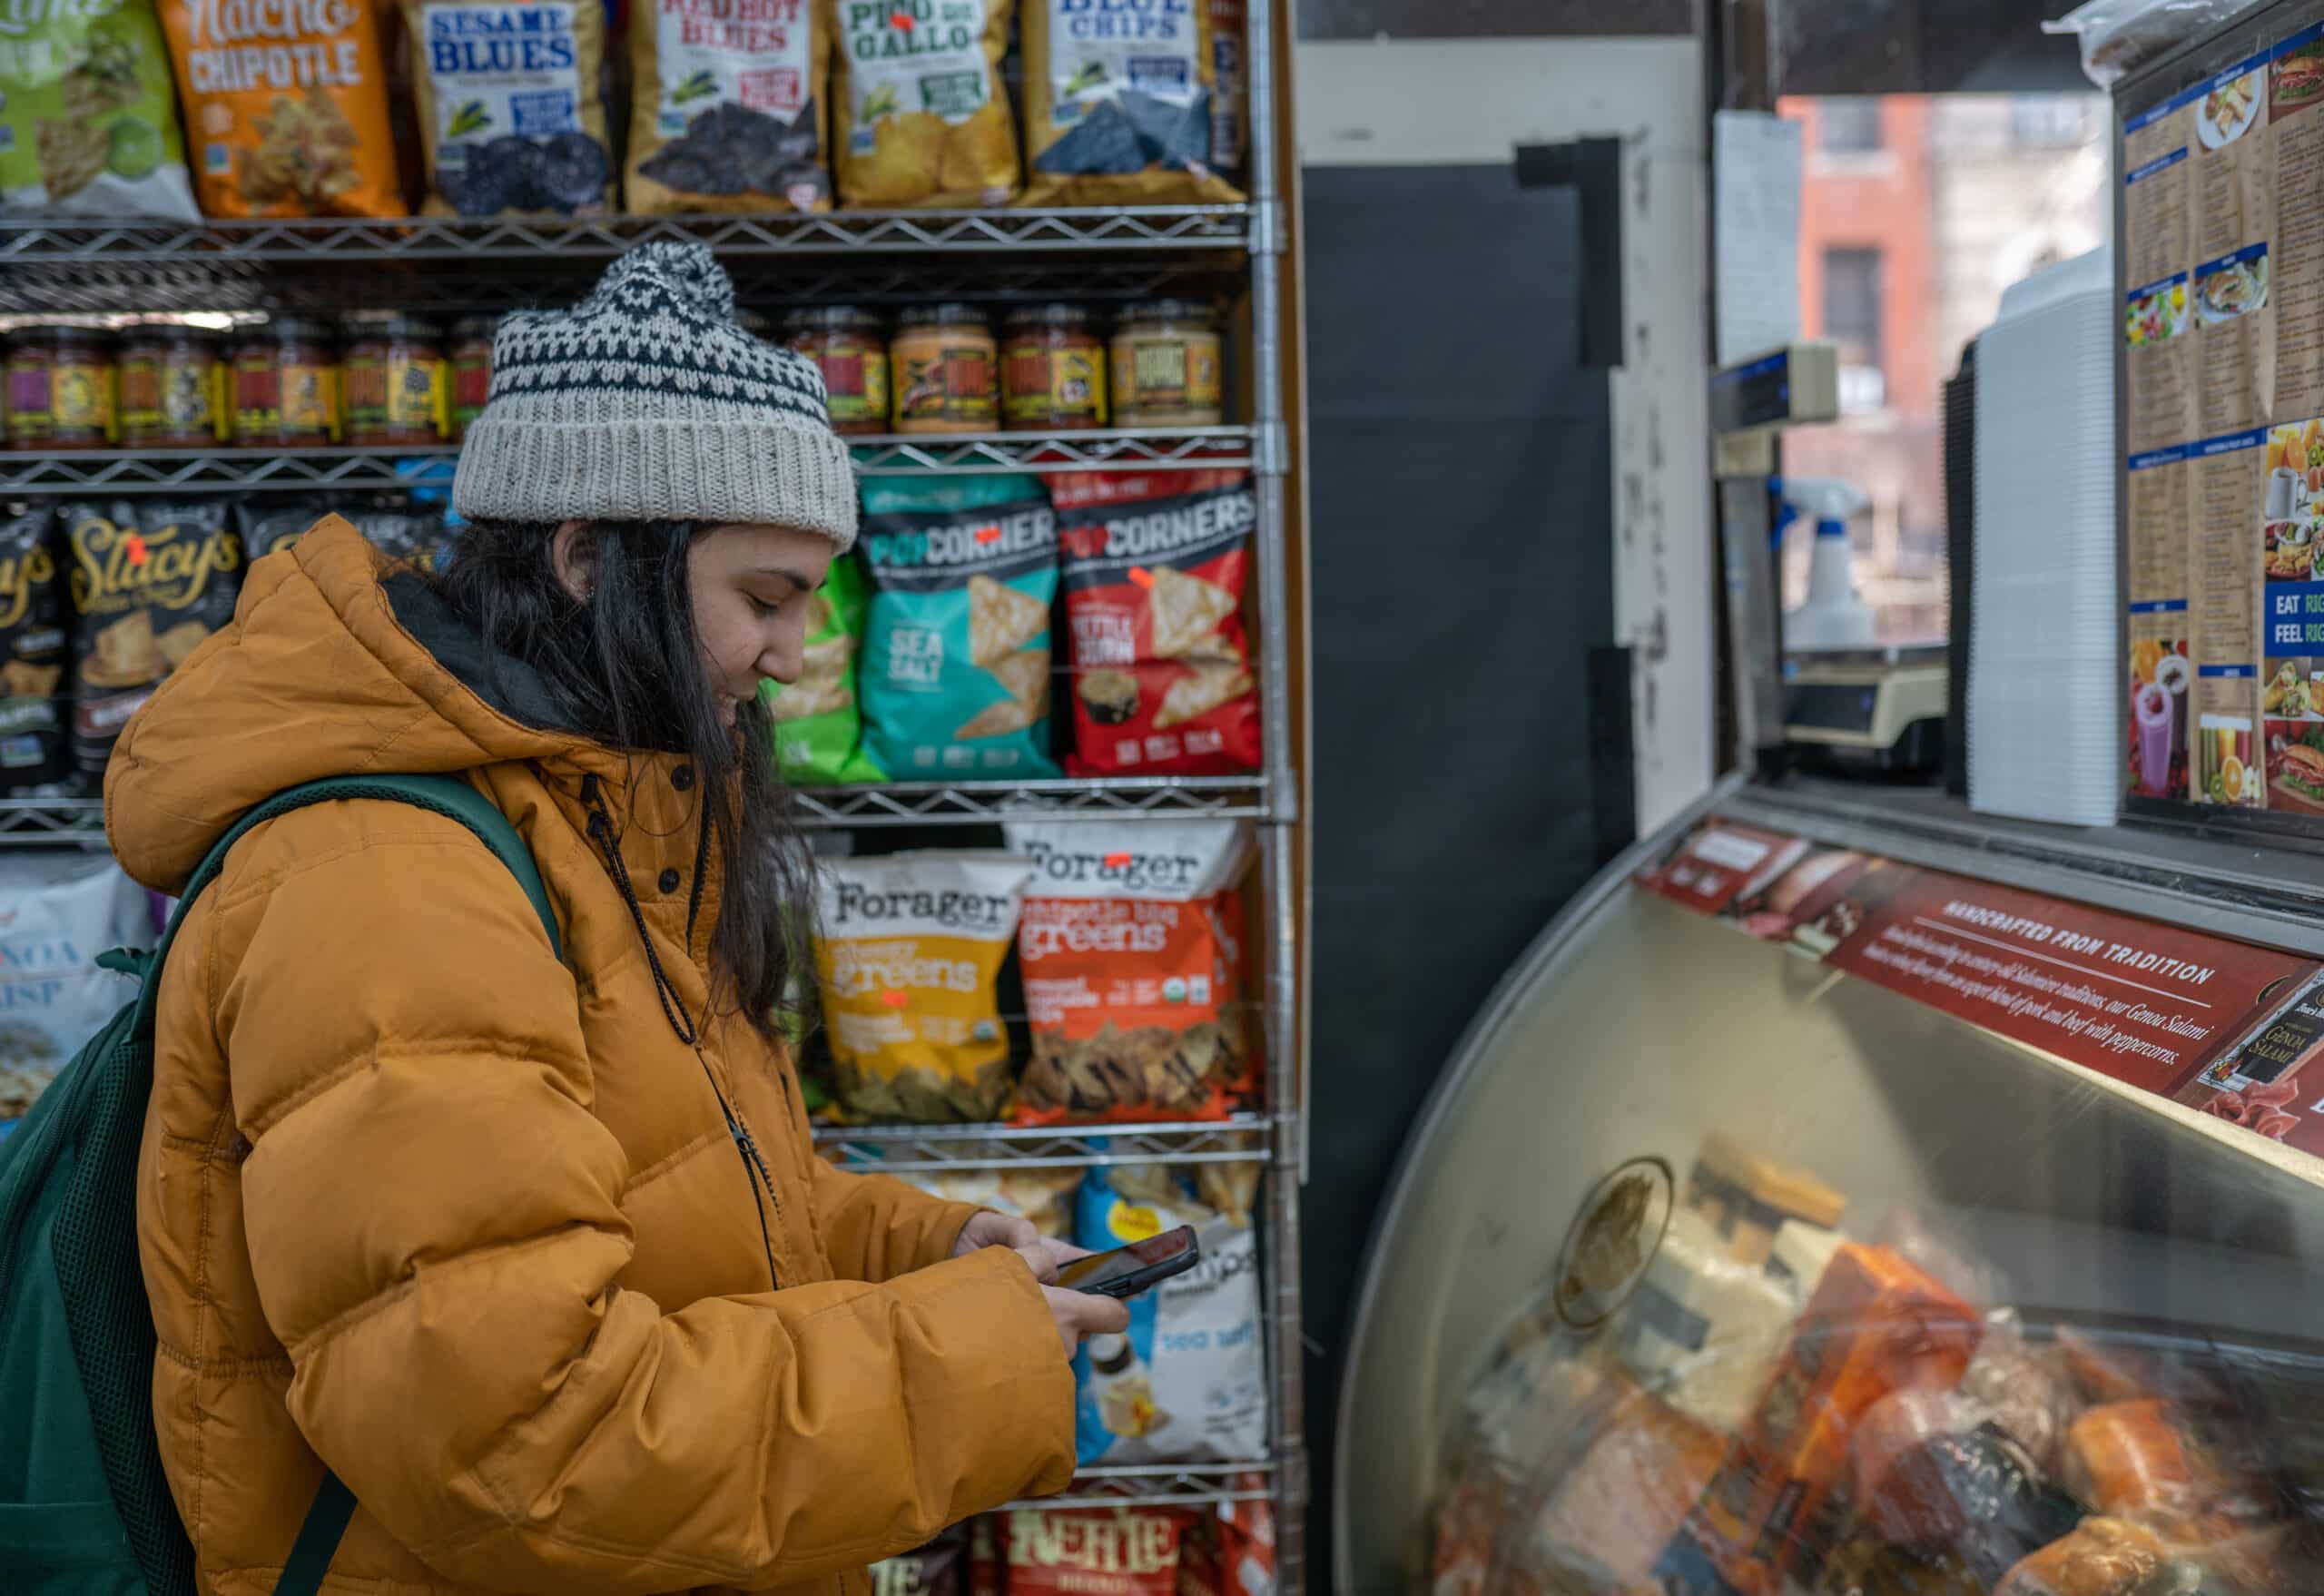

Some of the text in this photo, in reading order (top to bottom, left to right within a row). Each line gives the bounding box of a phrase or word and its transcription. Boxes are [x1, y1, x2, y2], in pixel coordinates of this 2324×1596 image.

[431, 7, 565, 36] SESAME
[682, 15, 787, 54] BLUES
[1069, 15, 1178, 39] CHIPS
[430, 36, 574, 74] BLUES
[855, 25, 970, 61] GALLO
[188, 41, 363, 93] CHIPOTLE
[1059, 494, 1256, 558] POPCORNERS
[2276, 595, 2301, 615] EAT
[890, 628, 943, 655] SEA
[2275, 624, 2303, 643] FEEL
[835, 882, 1008, 927] Forager
[1019, 921, 1167, 961] greens
[1943, 900, 2053, 941] HANDCRAFTED
[2050, 930, 2104, 955] FROM
[2102, 943, 2215, 984] TRADITION
[834, 959, 977, 999] greens
[2083, 1022, 2116, 1042] with
[2105, 1000, 2131, 1015] our
[2125, 1002, 2167, 1028] Genoa
[2162, 1014, 2215, 1040] Salami
